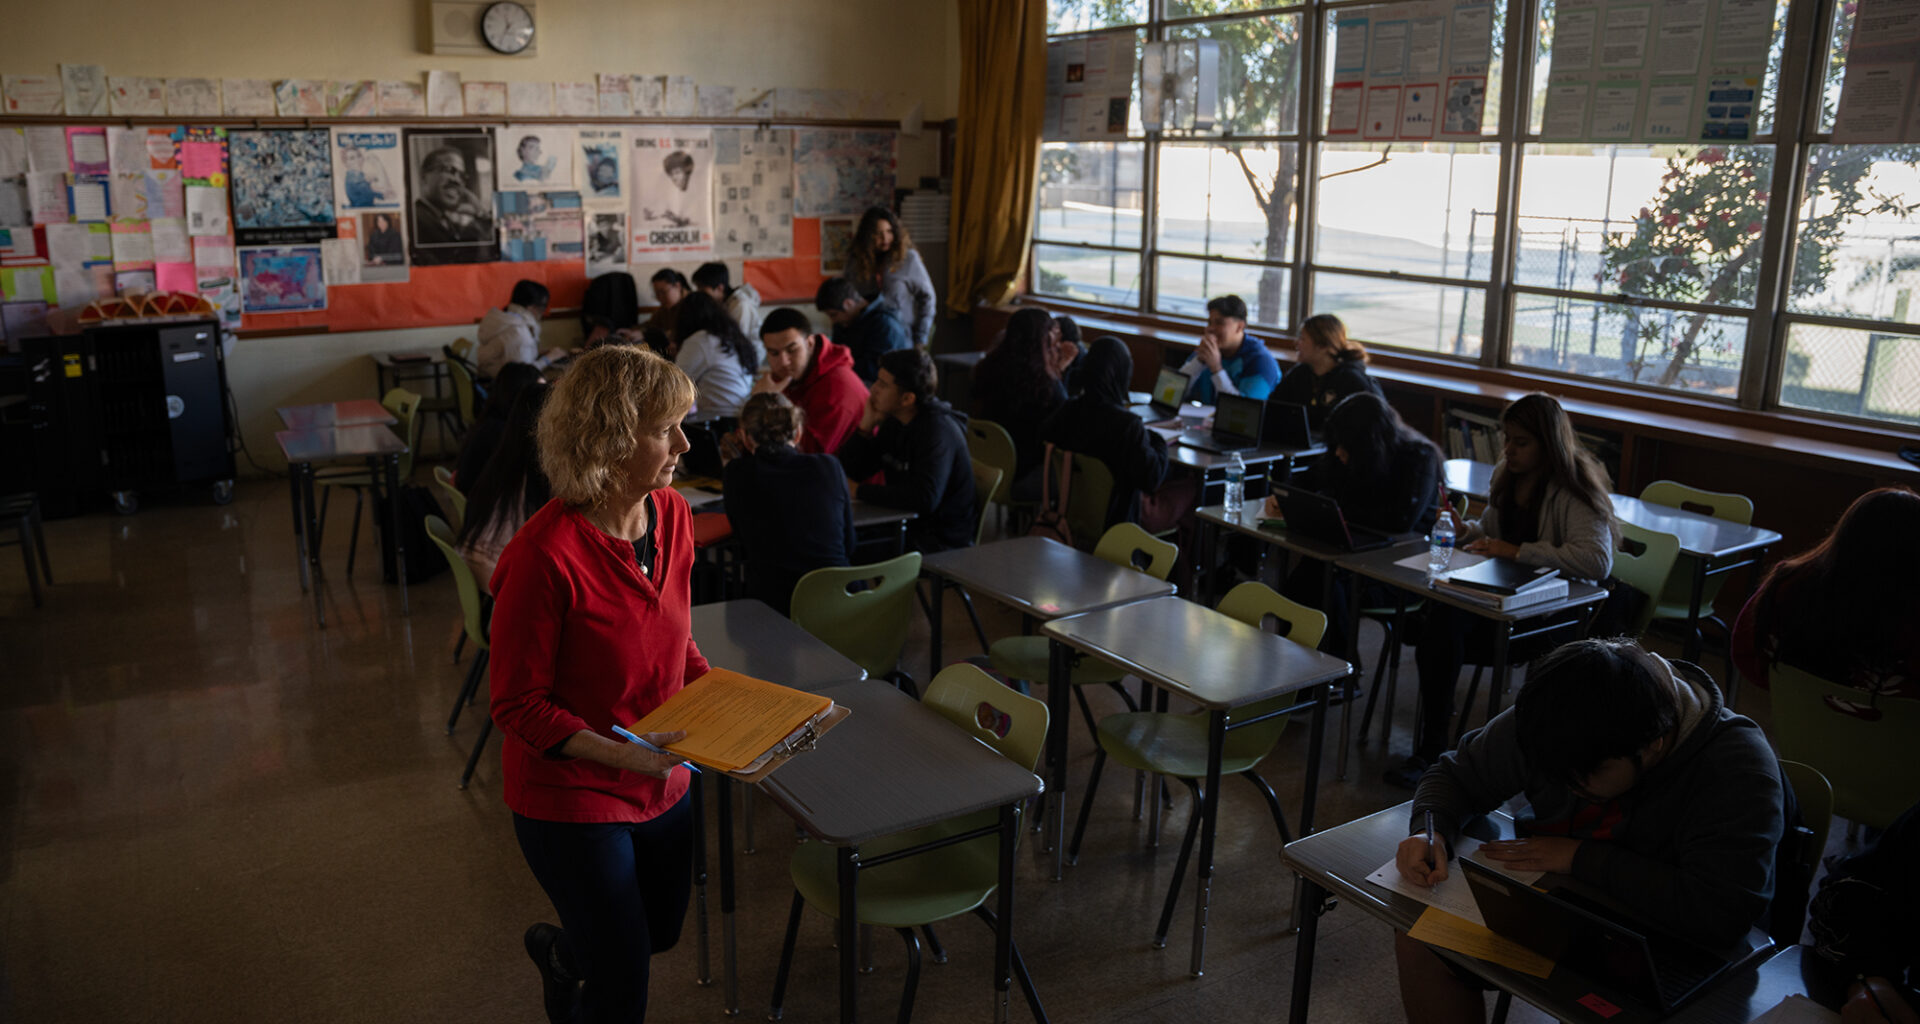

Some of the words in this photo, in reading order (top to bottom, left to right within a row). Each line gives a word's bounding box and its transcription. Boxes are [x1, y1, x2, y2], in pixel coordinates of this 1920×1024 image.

[340, 135, 353, 145] We
[354, 135, 370, 145] Can
[371, 135, 384, 145] Do
[635, 138, 656, 148] BRING
[649, 230, 700, 245] CHISHOLM
